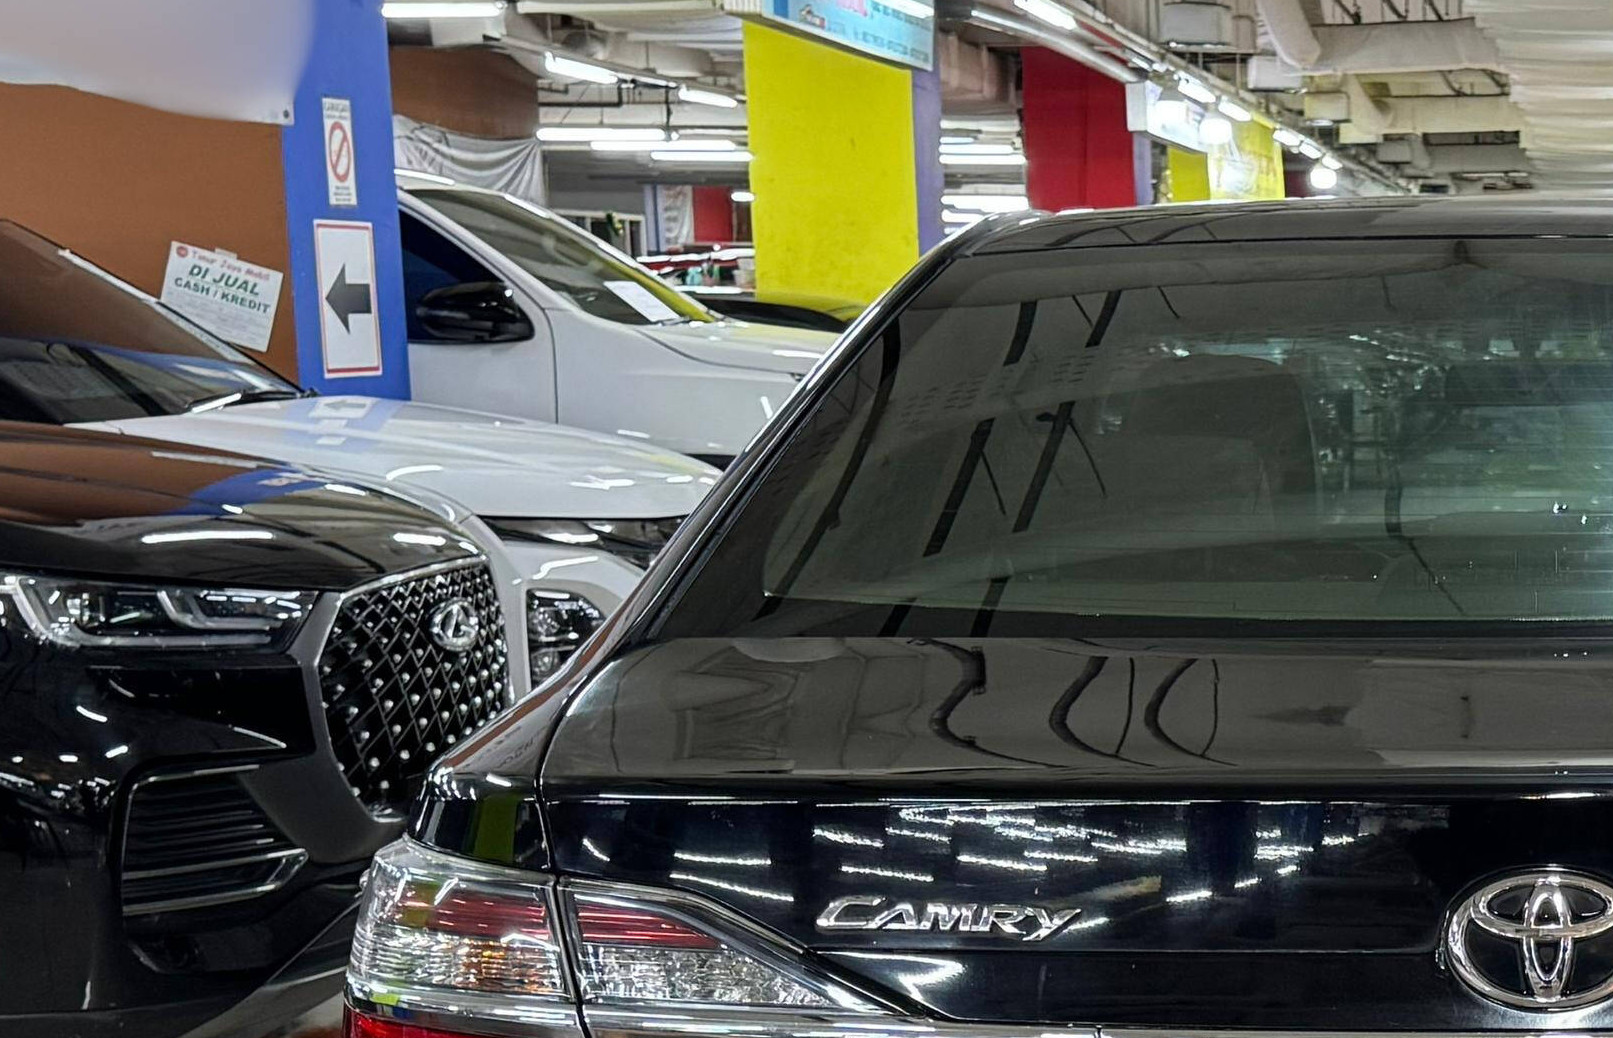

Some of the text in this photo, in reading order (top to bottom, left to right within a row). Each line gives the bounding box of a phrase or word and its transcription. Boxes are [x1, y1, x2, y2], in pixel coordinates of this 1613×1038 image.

[174, 276, 210, 296] CASH
[220, 291, 271, 314] KREDIT
[188, 263, 260, 296] DI JUAL
[815, 896, 1082, 942] CAMRY
